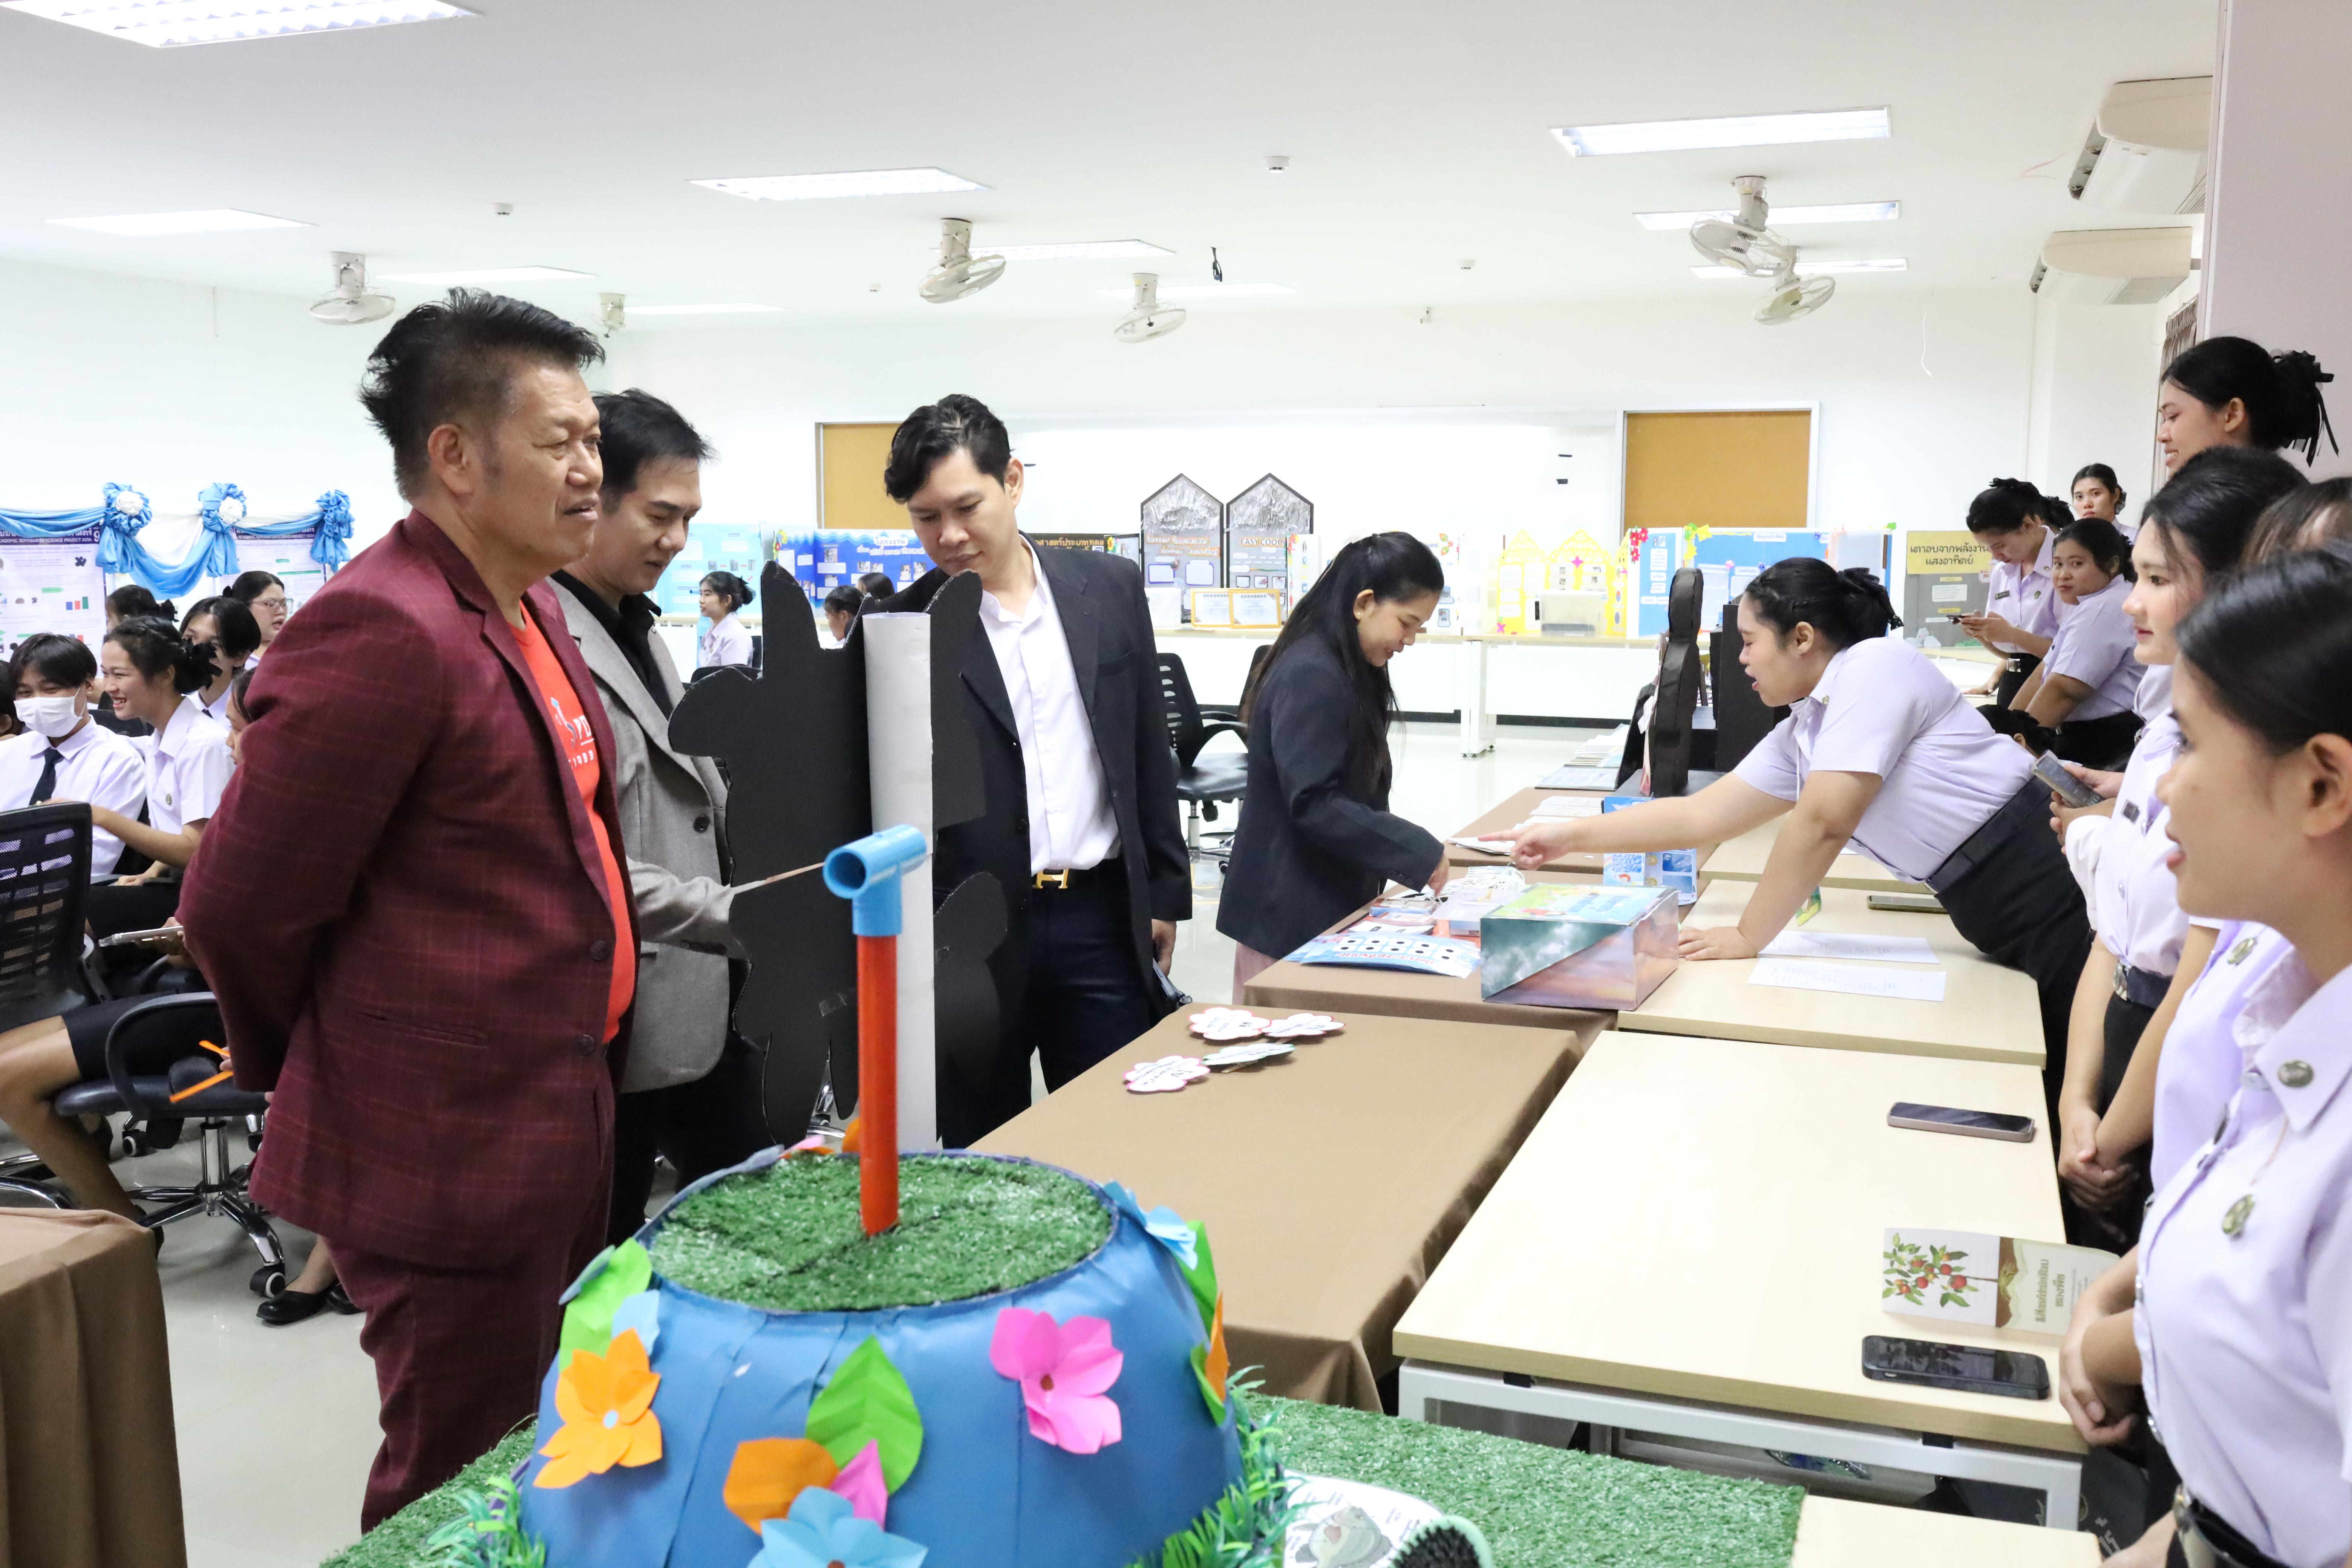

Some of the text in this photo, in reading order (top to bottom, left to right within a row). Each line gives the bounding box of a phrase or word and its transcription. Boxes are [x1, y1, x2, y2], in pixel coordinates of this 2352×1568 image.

[93, 531, 100, 542] 9
[875, 537, 906, 545] โครงงาน
[1910, 542, 1989, 553] เตาอบจากพลังงาน
[1926, 554, 1974, 565] แสงอาทิตย์
